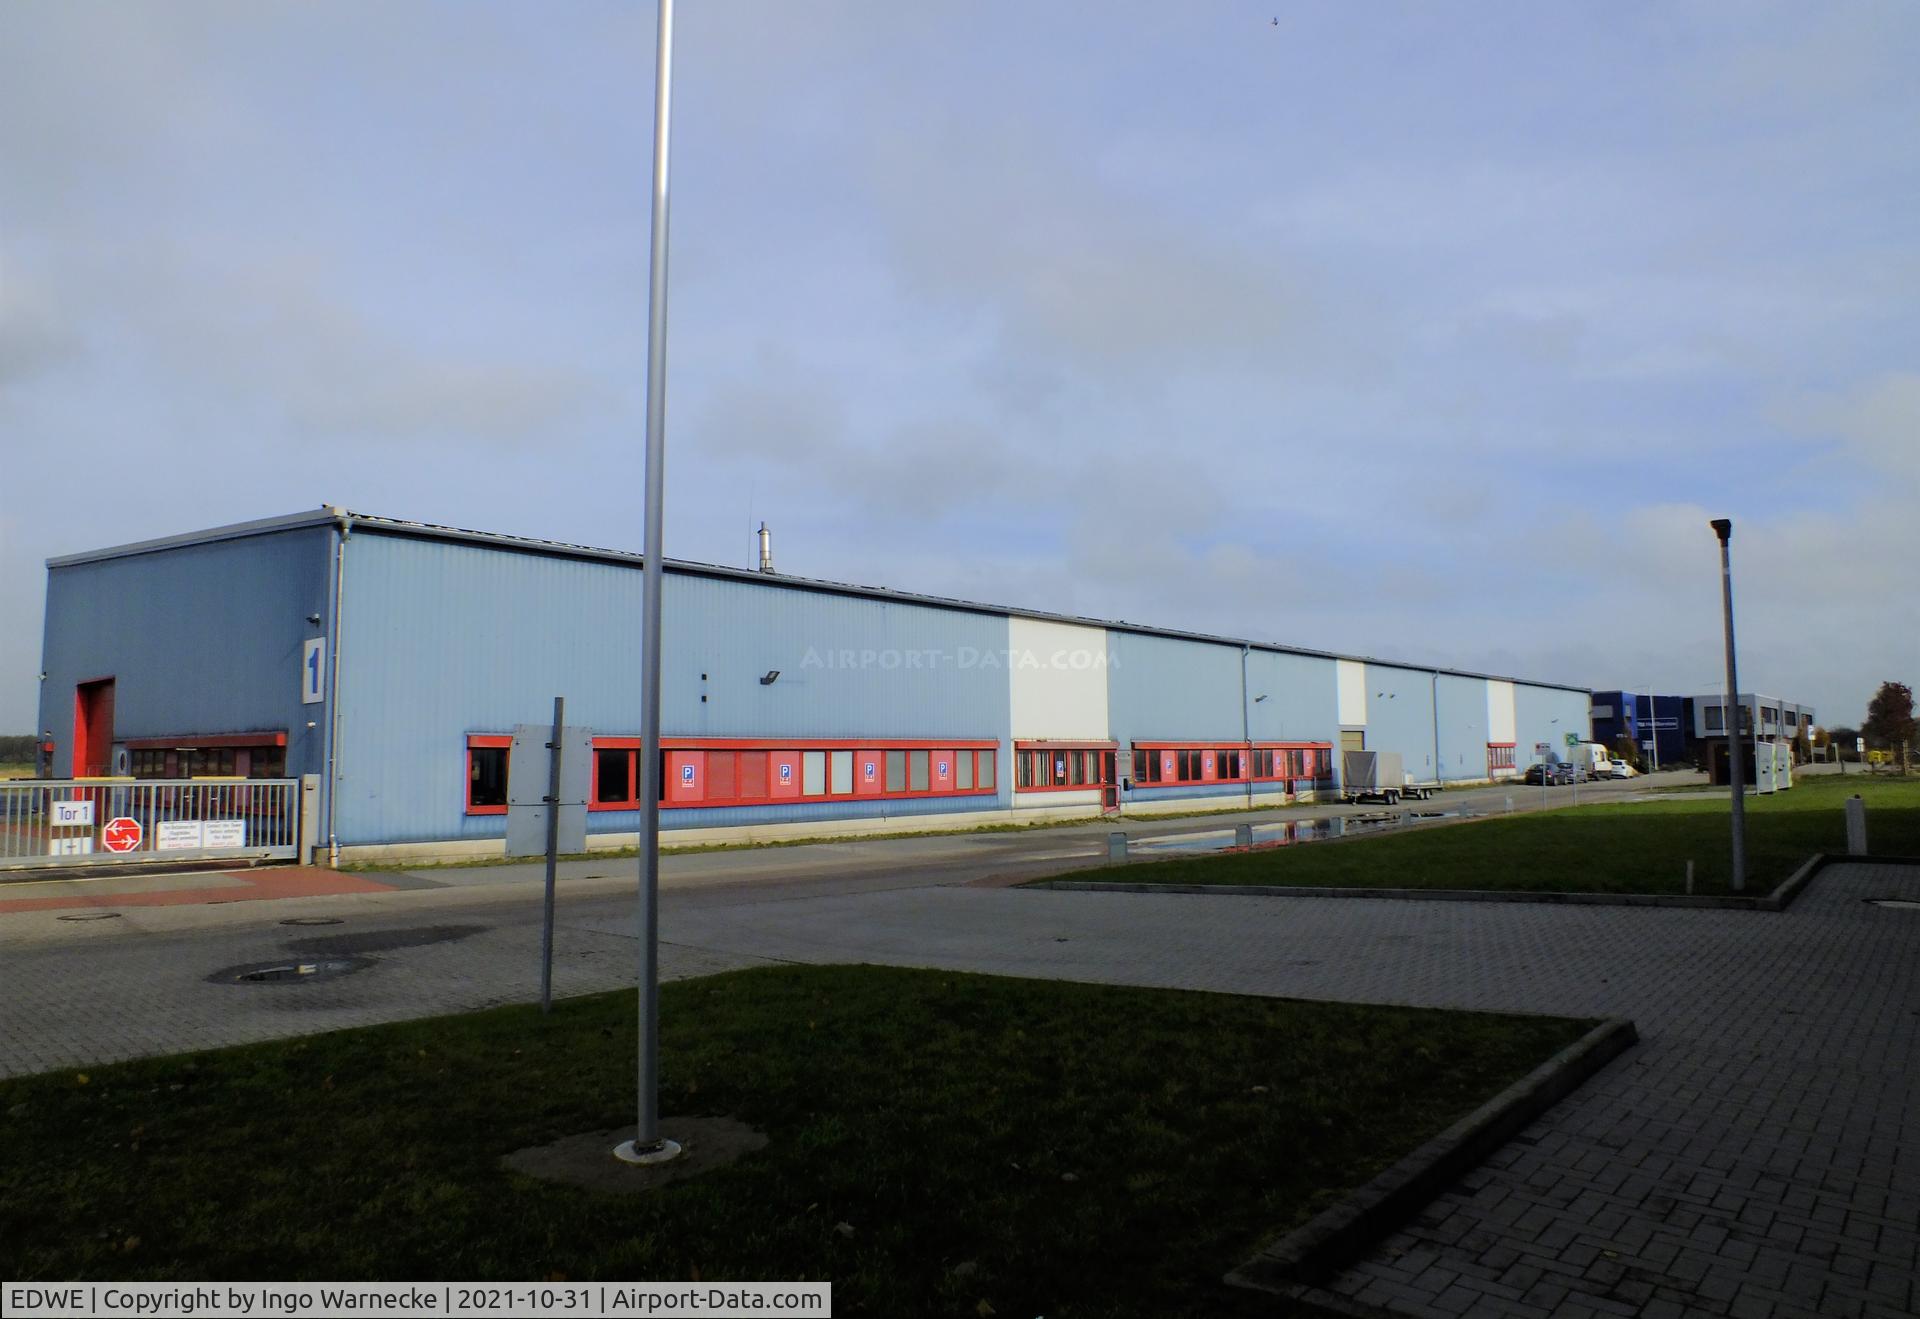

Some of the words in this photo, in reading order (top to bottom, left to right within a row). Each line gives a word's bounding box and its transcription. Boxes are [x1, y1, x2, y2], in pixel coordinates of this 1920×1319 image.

[309, 647, 319, 694] 1
[684, 767, 691, 779] P
[782, 766, 788, 777] P
[58, 806, 78, 820] Tor
[82, 806, 88, 820] 1
